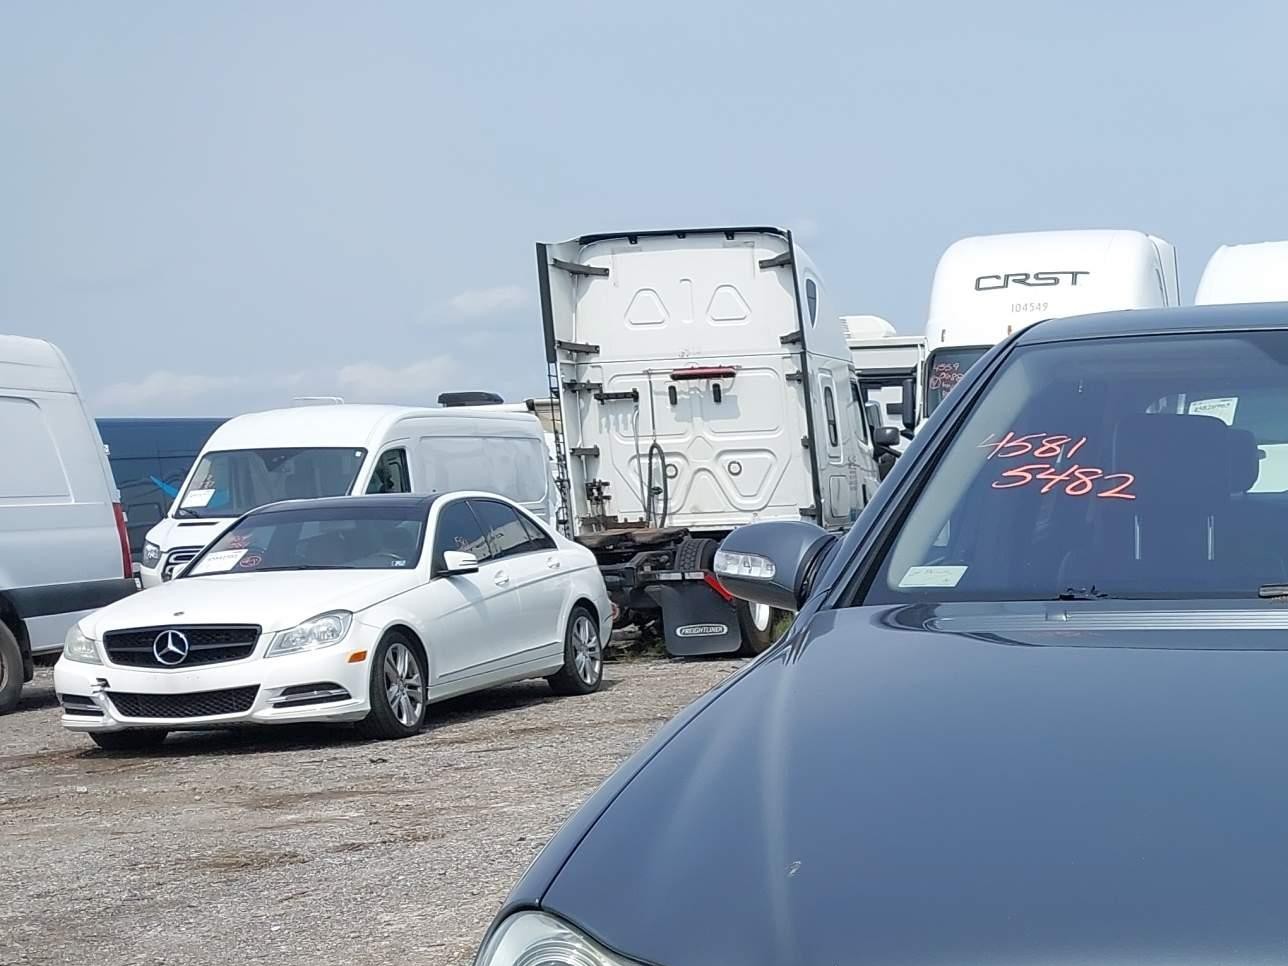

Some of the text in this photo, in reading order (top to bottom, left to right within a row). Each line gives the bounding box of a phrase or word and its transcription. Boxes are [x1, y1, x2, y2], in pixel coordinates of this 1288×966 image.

[974, 271, 1091, 291] CRST
[1010, 302, 1049, 313] 104549
[976, 431, 1087, 460] 4581
[992, 464, 1136, 499] 5482
